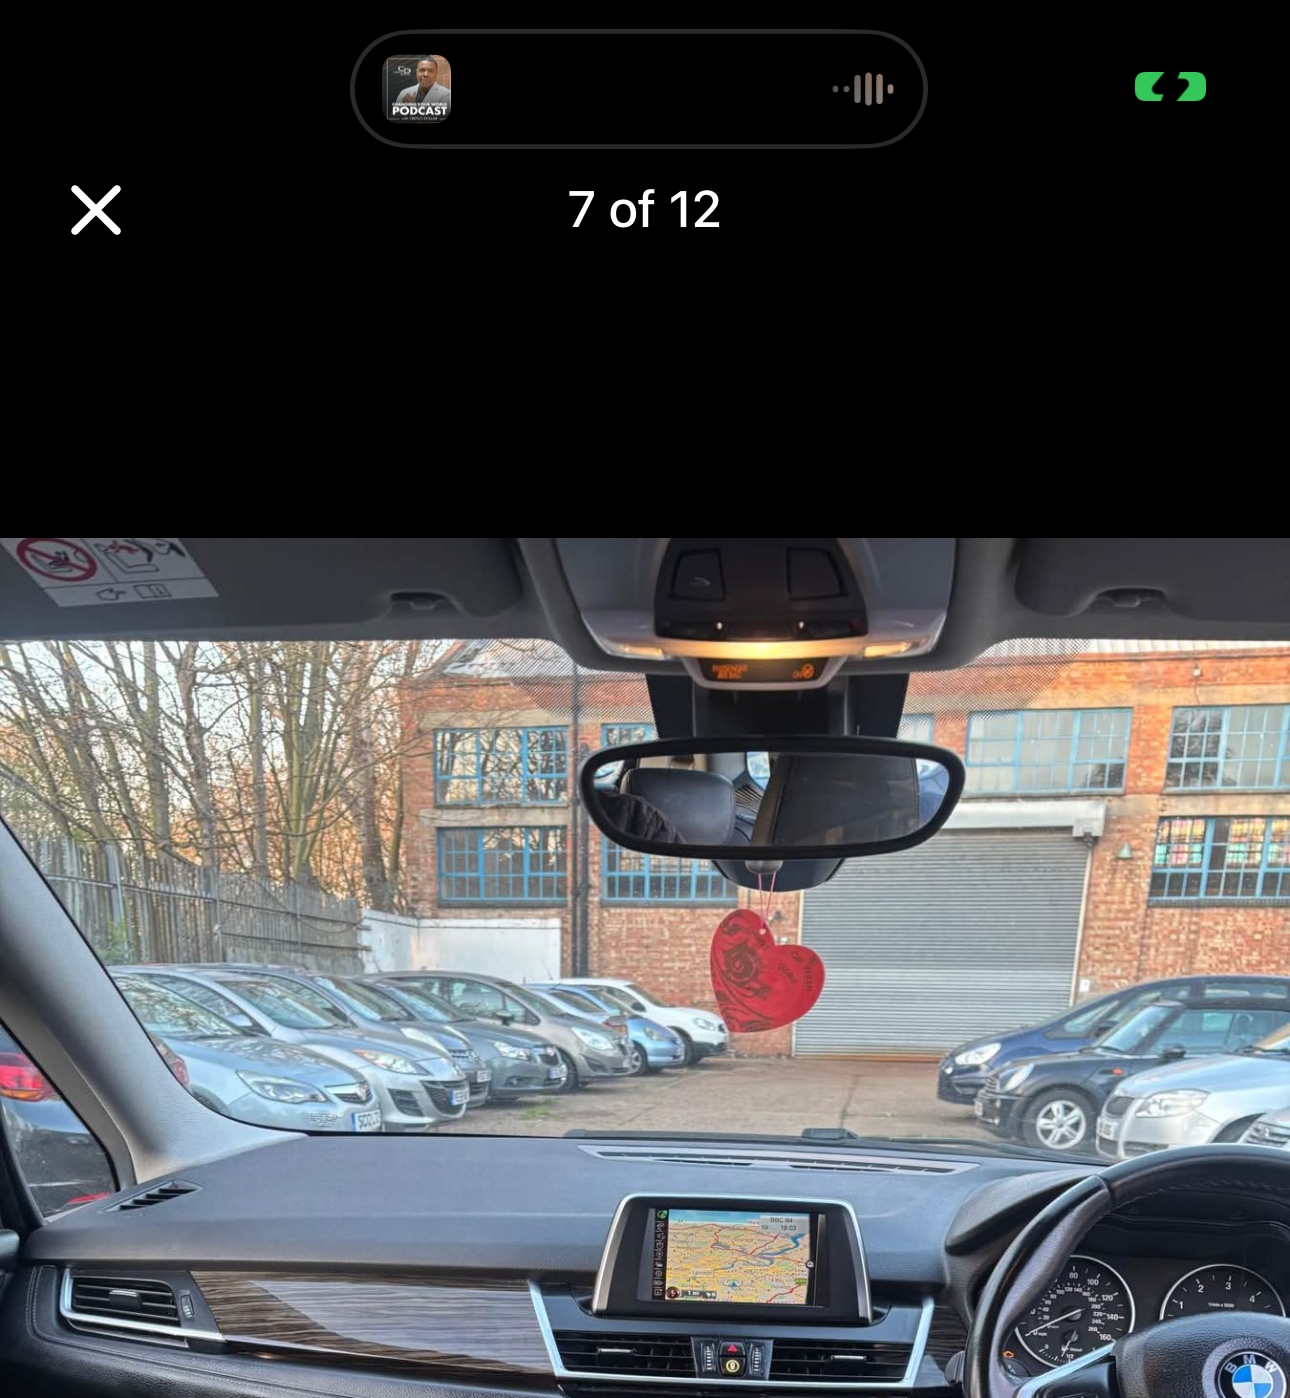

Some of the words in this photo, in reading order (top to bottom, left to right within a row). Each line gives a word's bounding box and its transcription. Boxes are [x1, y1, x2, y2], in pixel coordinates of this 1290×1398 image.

[1197, 1284, 1204, 1293] 2
[1225, 1282, 1232, 1290] 3
[1249, 1295, 1256, 1303] 4
[1179, 1301, 1183, 1309] 1
[1224, 1354, 1278, 1374] BMW
